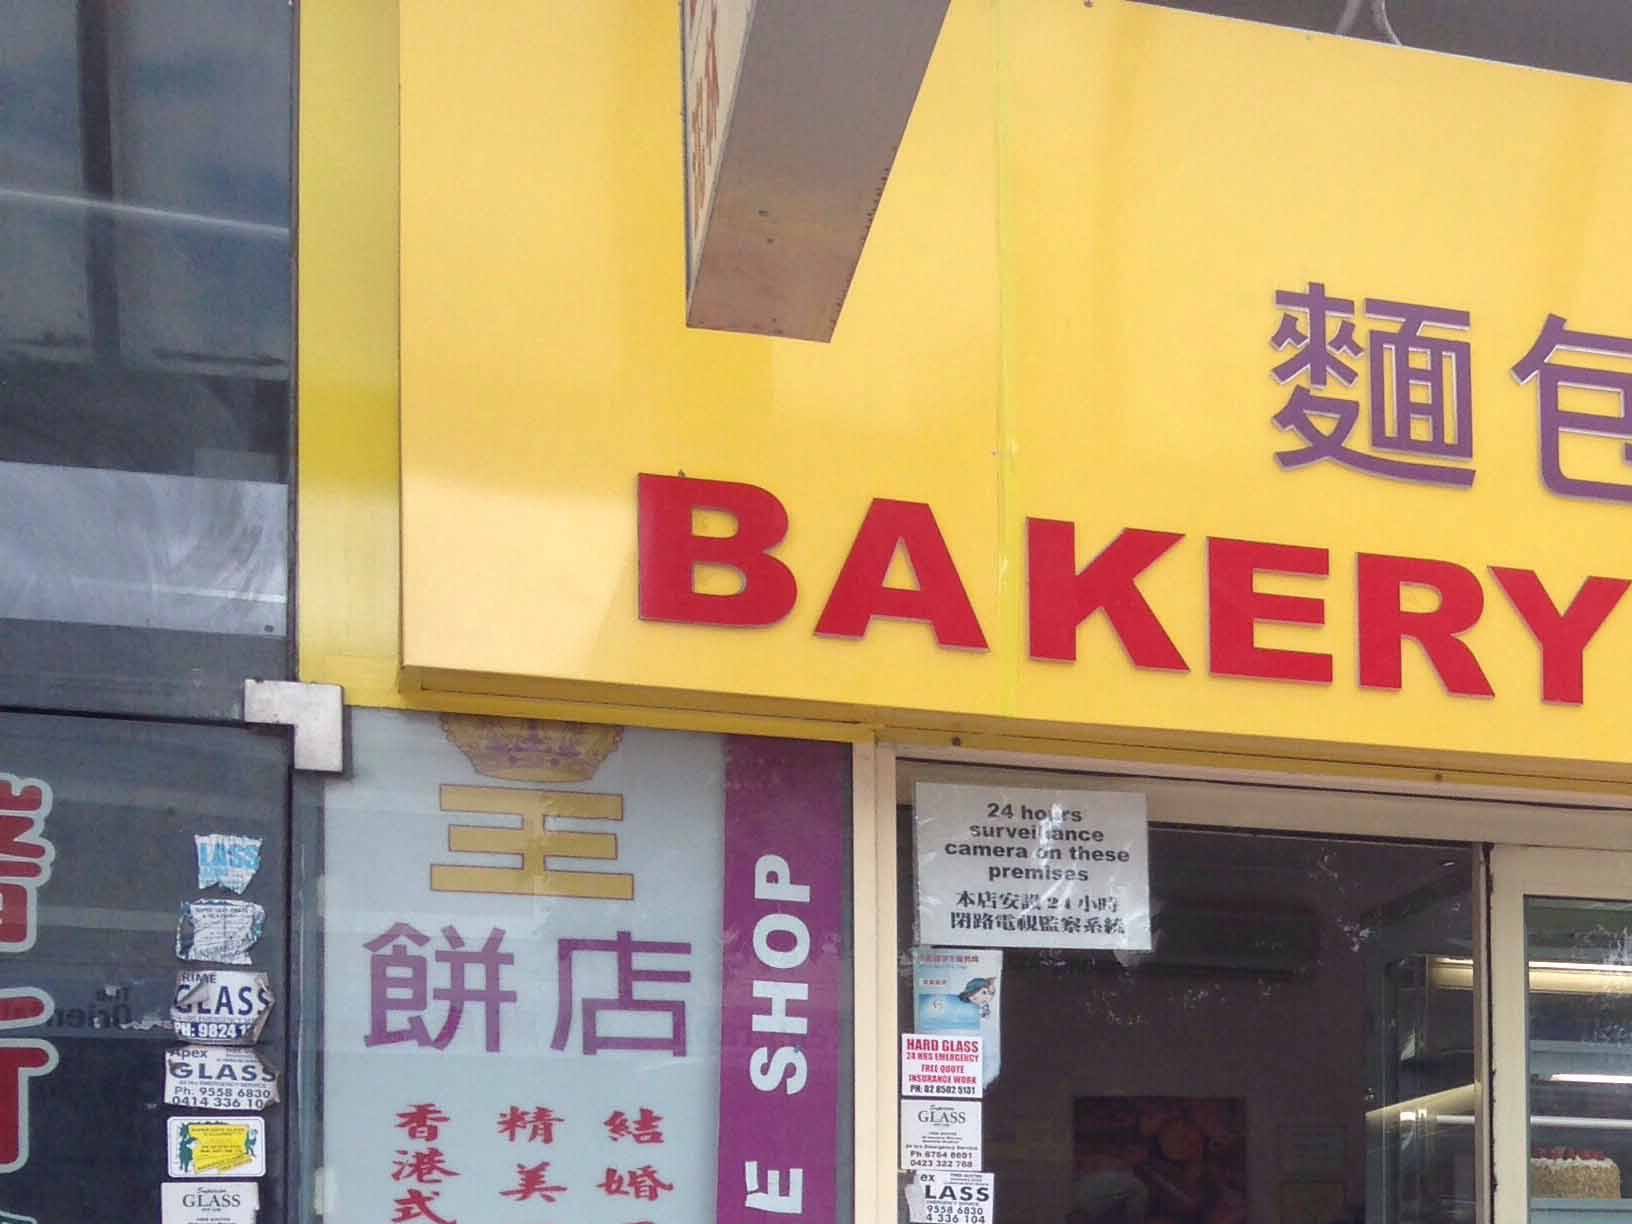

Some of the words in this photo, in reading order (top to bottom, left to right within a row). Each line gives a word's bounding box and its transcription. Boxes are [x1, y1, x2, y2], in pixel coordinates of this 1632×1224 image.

[636, 471, 1632, 706] BAKERY
[987, 803, 1014, 819] 24
[1020, 805, 1082, 822] hors
[969, 822, 1105, 842] surveiance
[430, 784, 634, 900] 王
[944, 843, 1028, 859] camera
[1036, 847, 1062, 860] on
[1070, 846, 1130, 862] these
[988, 864, 1089, 883] premises
[750, 853, 811, 1095] SHOP
[362, 922, 692, 1057] 餅店
[906, 1038, 939, 1052] HARD
[942, 1039, 979, 1053] GLASS
[169, 1062, 276, 1082] GLASS
[200, 1087, 232, 1097] 9558
[213, 1097, 241, 1108] 336
[918, 1111, 966, 1124] GLASS
[920, 1175, 936, 1183] ex
[182, 1194, 241, 1208] GLASS
[925, 1185, 990, 1202] LASS
[937, 1215, 959, 1223] 336
